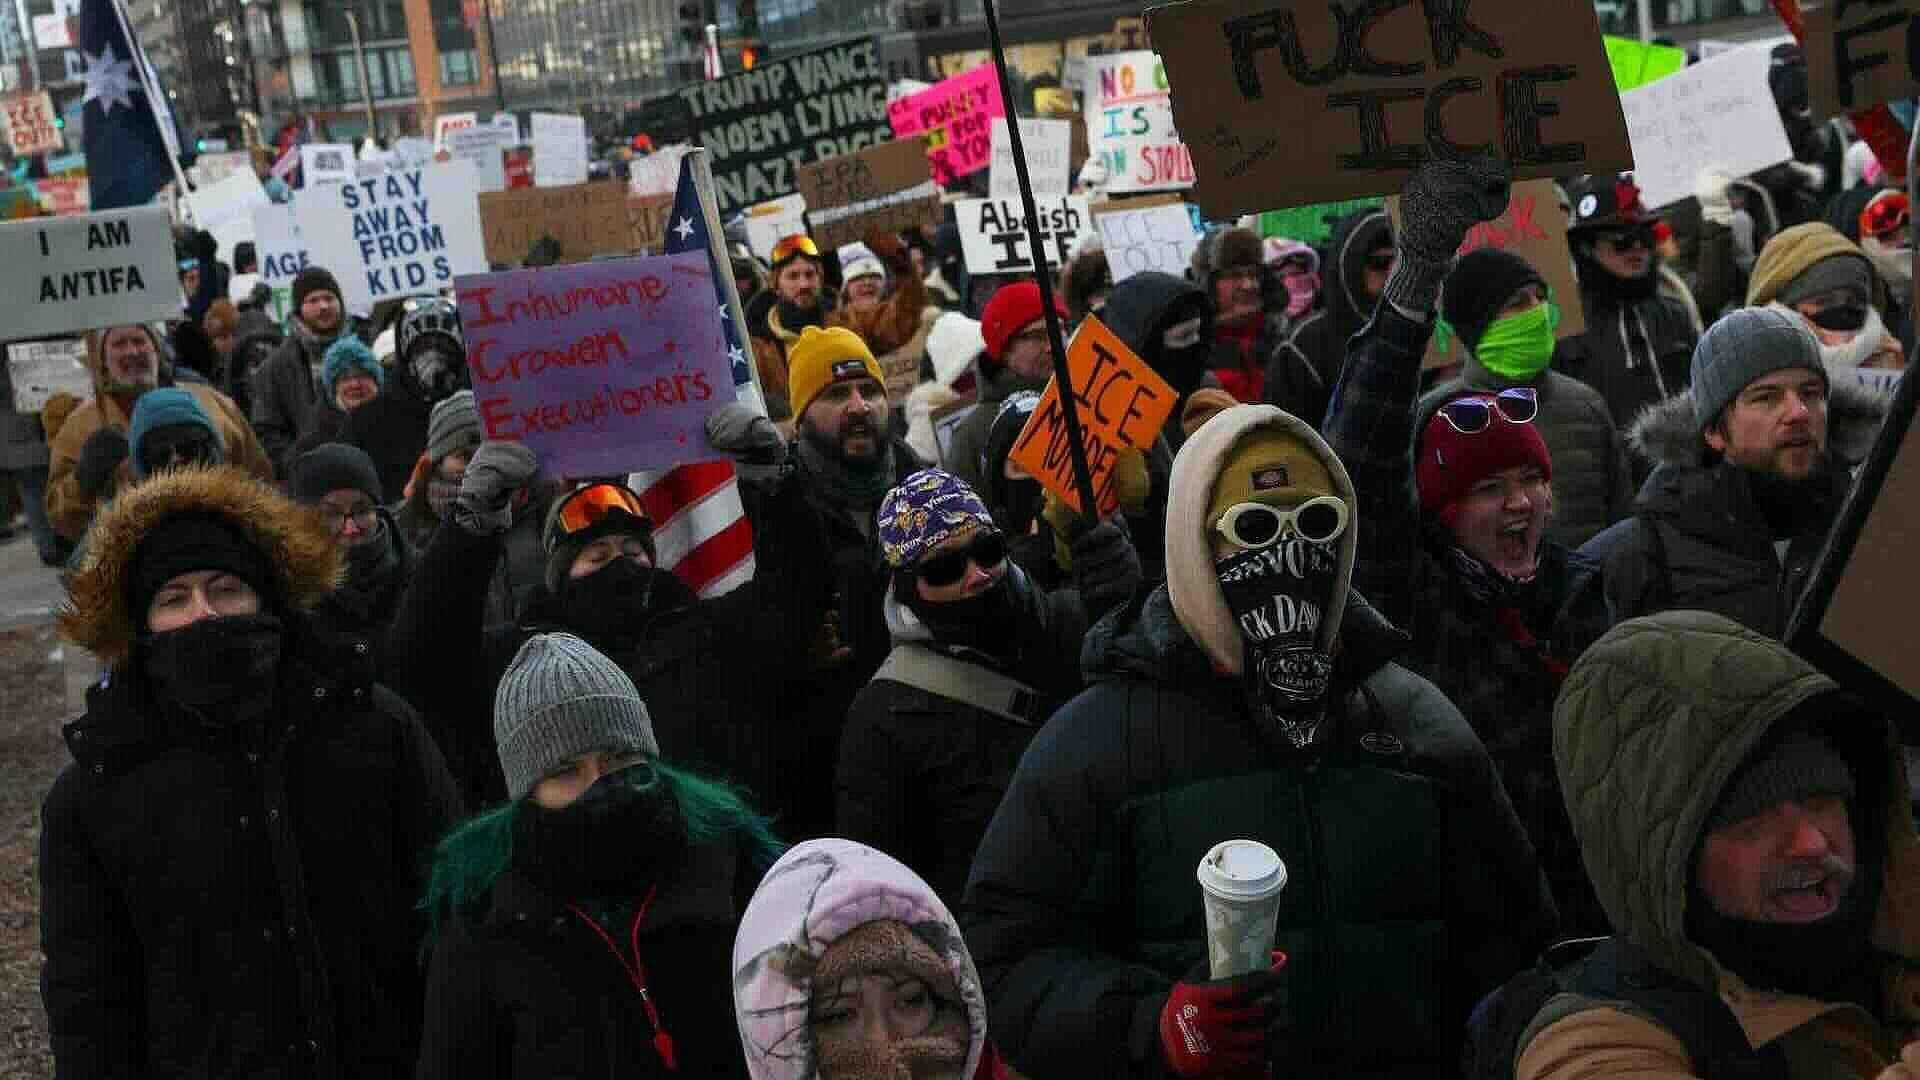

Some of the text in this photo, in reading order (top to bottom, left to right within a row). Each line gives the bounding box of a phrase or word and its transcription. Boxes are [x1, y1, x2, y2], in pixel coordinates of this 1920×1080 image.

[789, 41, 881, 94] VANCE
[1223, 0, 1506, 100] FUCK
[1101, 64, 1135, 97] NO
[1104, 107, 1151, 138] IS
[1326, 64, 1586, 171] ICE
[342, 170, 423, 209] STAY
[39, 219, 131, 257] I AM
[353, 199, 429, 241] AWAY
[359, 223, 446, 265] FROM
[39, 263, 145, 303] ANTIFA
[368, 255, 451, 296] KIDS
[460, 273, 669, 329] Inhumane
[468, 327, 629, 384] Craven
[1072, 340, 1158, 445] ICE
